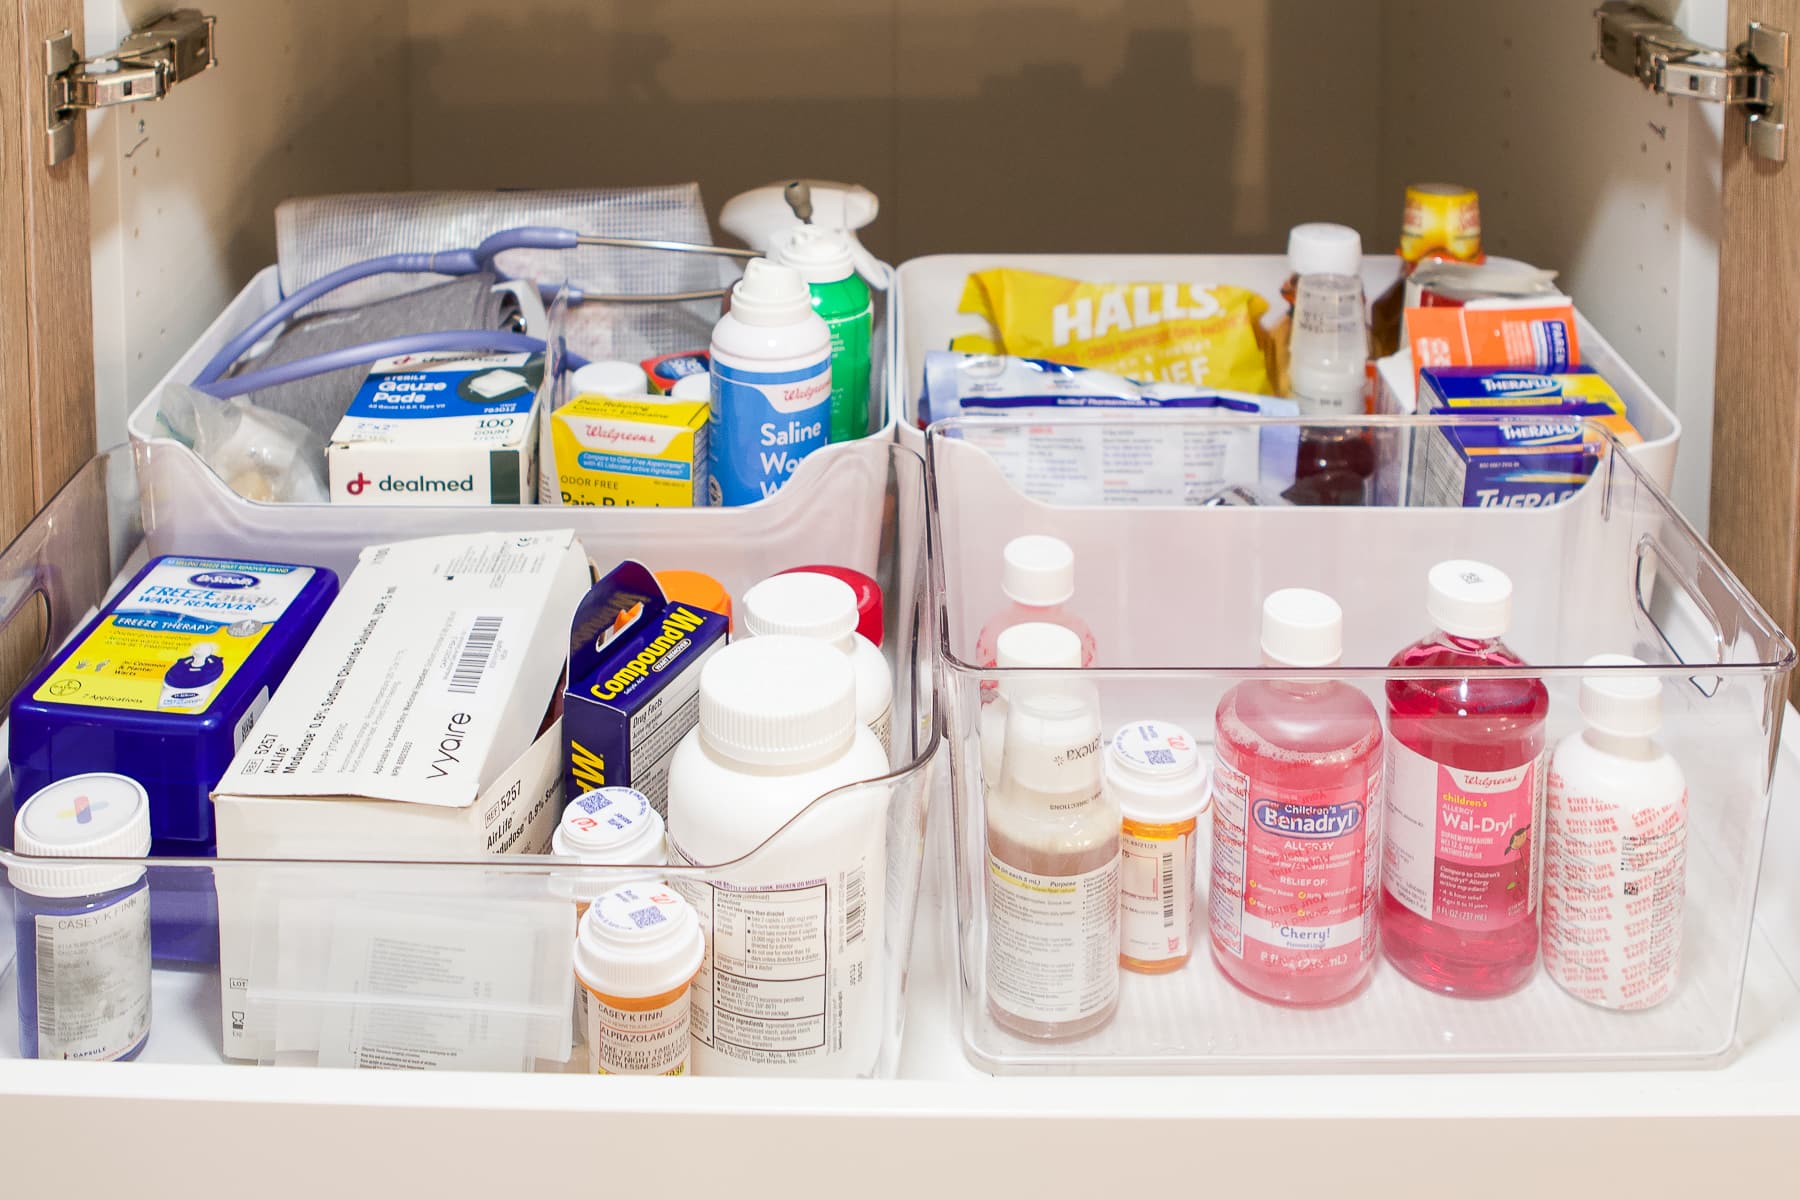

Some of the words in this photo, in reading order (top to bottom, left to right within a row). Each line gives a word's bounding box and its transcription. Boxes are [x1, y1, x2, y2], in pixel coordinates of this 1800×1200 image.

[1053, 283, 1221, 347] HALLS
[378, 381, 447, 391] Gauze
[1481, 377, 1554, 392] THERAFLU
[372, 391, 426, 403] Pads
[479, 418, 514, 428] 100
[585, 424, 655, 443] Walgreens
[760, 420, 822, 447] Saline
[1499, 422, 1577, 440] THERAFLU
[379, 474, 473, 492] dealmed
[560, 475, 591, 487] ODOR
[594, 477, 618, 490] FREE
[138, 595, 180, 605] WART
[183, 598, 256, 611] REMOVER
[117, 617, 159, 629] FREEZE
[160, 621, 216, 632] THERAPY
[321, 679, 346, 706] Sodium
[337, 646, 364, 677] Chloride
[90, 694, 144, 704] Applications
[632, 711, 647, 729] Drug
[647, 697, 663, 716] Facts
[254, 733, 279, 755] 5257
[426, 712, 472, 780] vyaire
[1464, 774, 1517, 789] Walgreens
[500, 779, 521, 811] 5257
[1442, 791, 1488, 808] children's
[528, 800, 545, 825] 0.9%
[1284, 804, 1337, 816] Children's
[1442, 803, 1474, 815] ALLERGY
[1264, 806, 1354, 834] Benadryl
[1440, 864, 1466, 878] Compare
[1473, 871, 1501, 879] Children's
[776, 882, 796, 890] BROKEN
[1049, 880, 1077, 889] Purpose
[1279, 876, 1312, 886] RELIEF
[1312, 878, 1329, 886] OF:
[1440, 880, 1457, 889] active
[1468, 878, 1490, 887] Allergy
[1442, 896, 1456, 906] Ages
[1454, 891, 1467, 900] hour
[1442, 906, 1448, 915] FL
[1449, 908, 1459, 918] OZ
[58, 916, 98, 929] CASEY
[104, 911, 112, 921] K
[1280, 926, 1331, 942] Cherry!
[232, 980, 246, 988] LOT
[717, 972, 730, 981] Other
[730, 977, 759, 989] information
[721, 981, 738, 992] SODIUM
[598, 1003, 627, 1021] CASEY
[629, 1014, 636, 1022] K
[639, 1010, 663, 1022] FINN
[717, 1010, 735, 1022] Inactive
[736, 1016, 764, 1028] ingredients
[600, 1026, 666, 1043] ALPRAZOLAM
[73, 1045, 107, 1058] CAPSULE
[601, 1040, 616, 1054] TAKE
[634, 1049, 645, 1057] TO
[734, 1046, 751, 1056] Target
[624, 1056, 649, 1064] NIGHT
[651, 1054, 662, 1063] AS
[749, 1055, 766, 1064] Target
